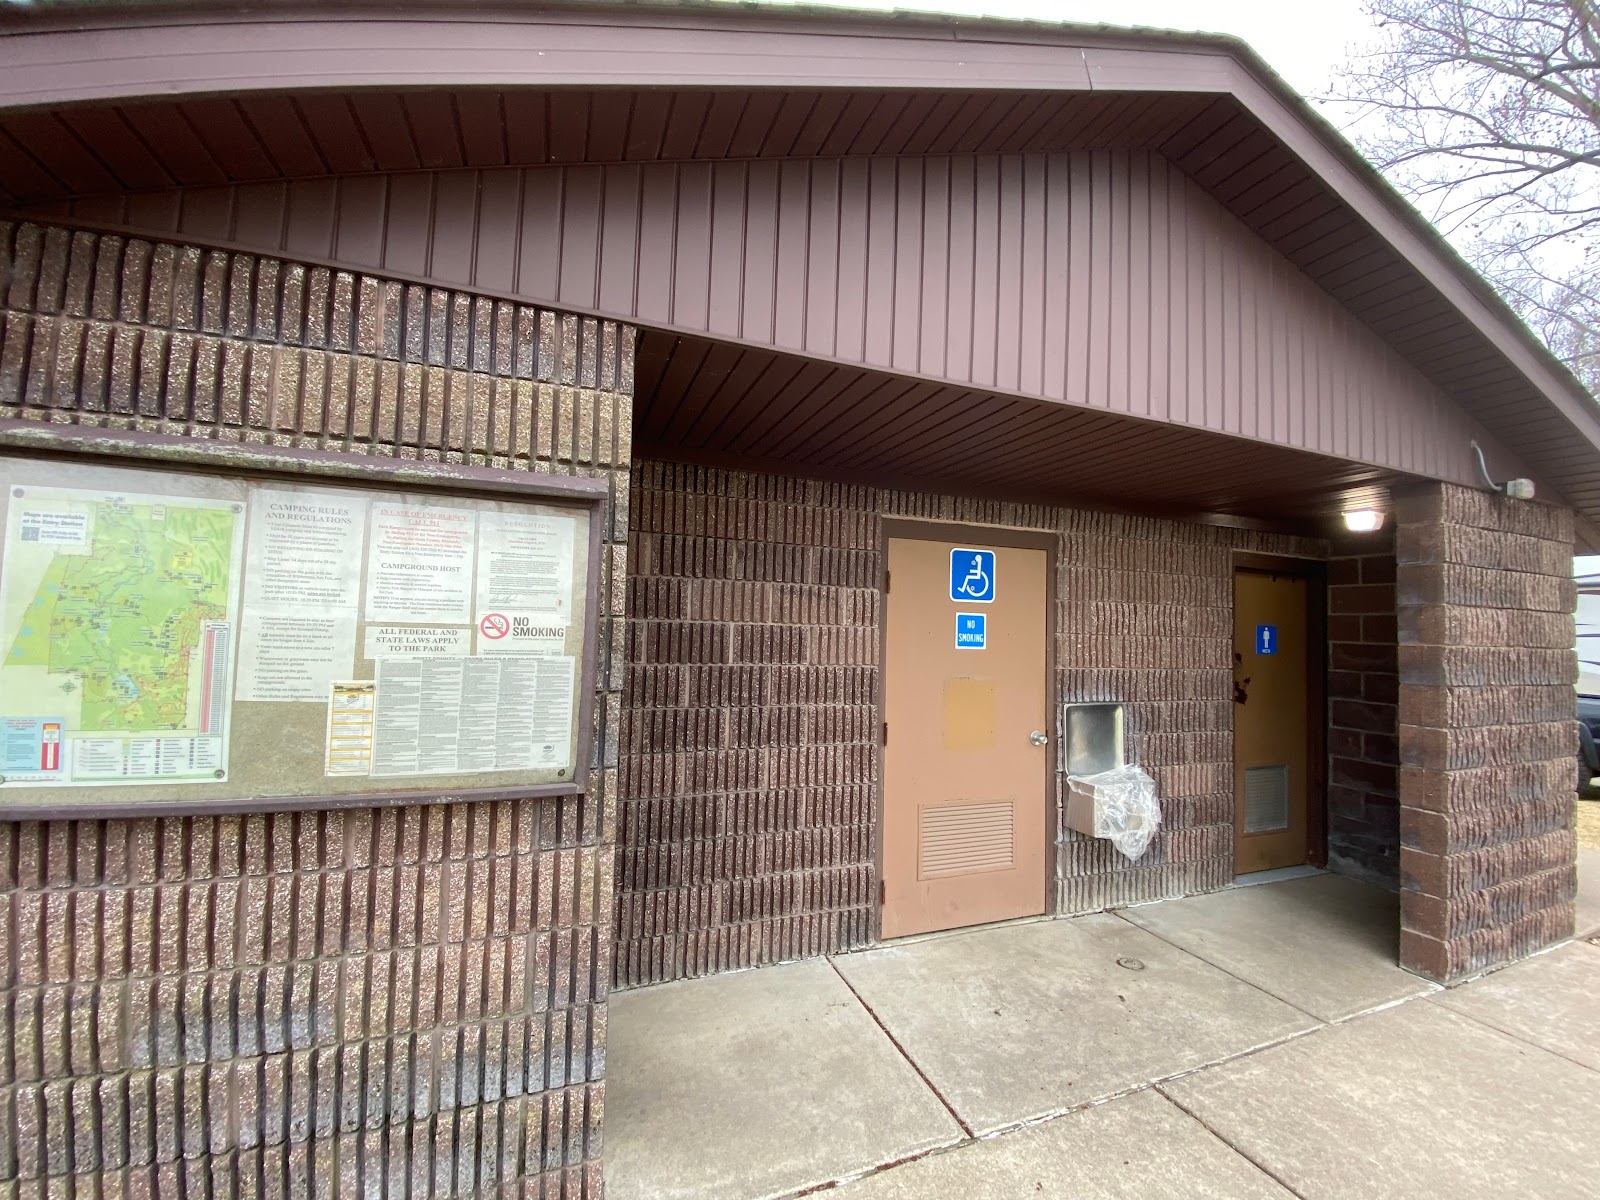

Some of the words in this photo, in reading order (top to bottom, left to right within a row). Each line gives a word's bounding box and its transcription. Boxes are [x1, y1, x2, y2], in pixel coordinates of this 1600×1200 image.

[270, 504, 316, 513] CAMPING
[319, 507, 349, 515] RULES
[265, 512, 285, 520] AND
[287, 514, 352, 524] REGULATIONS
[423, 512, 466, 521] EMERGENCY
[505, 521, 551, 529] RESOLUTION
[381, 563, 438, 572] CAMPGROUND
[513, 617, 530, 627] NO
[967, 620, 976, 629] NO
[399, 628, 438, 636] FEDERAL
[512, 627, 564, 638] SMOKING
[433, 637, 459, 645] APPLY
[959, 633, 984, 643] SMOKING
